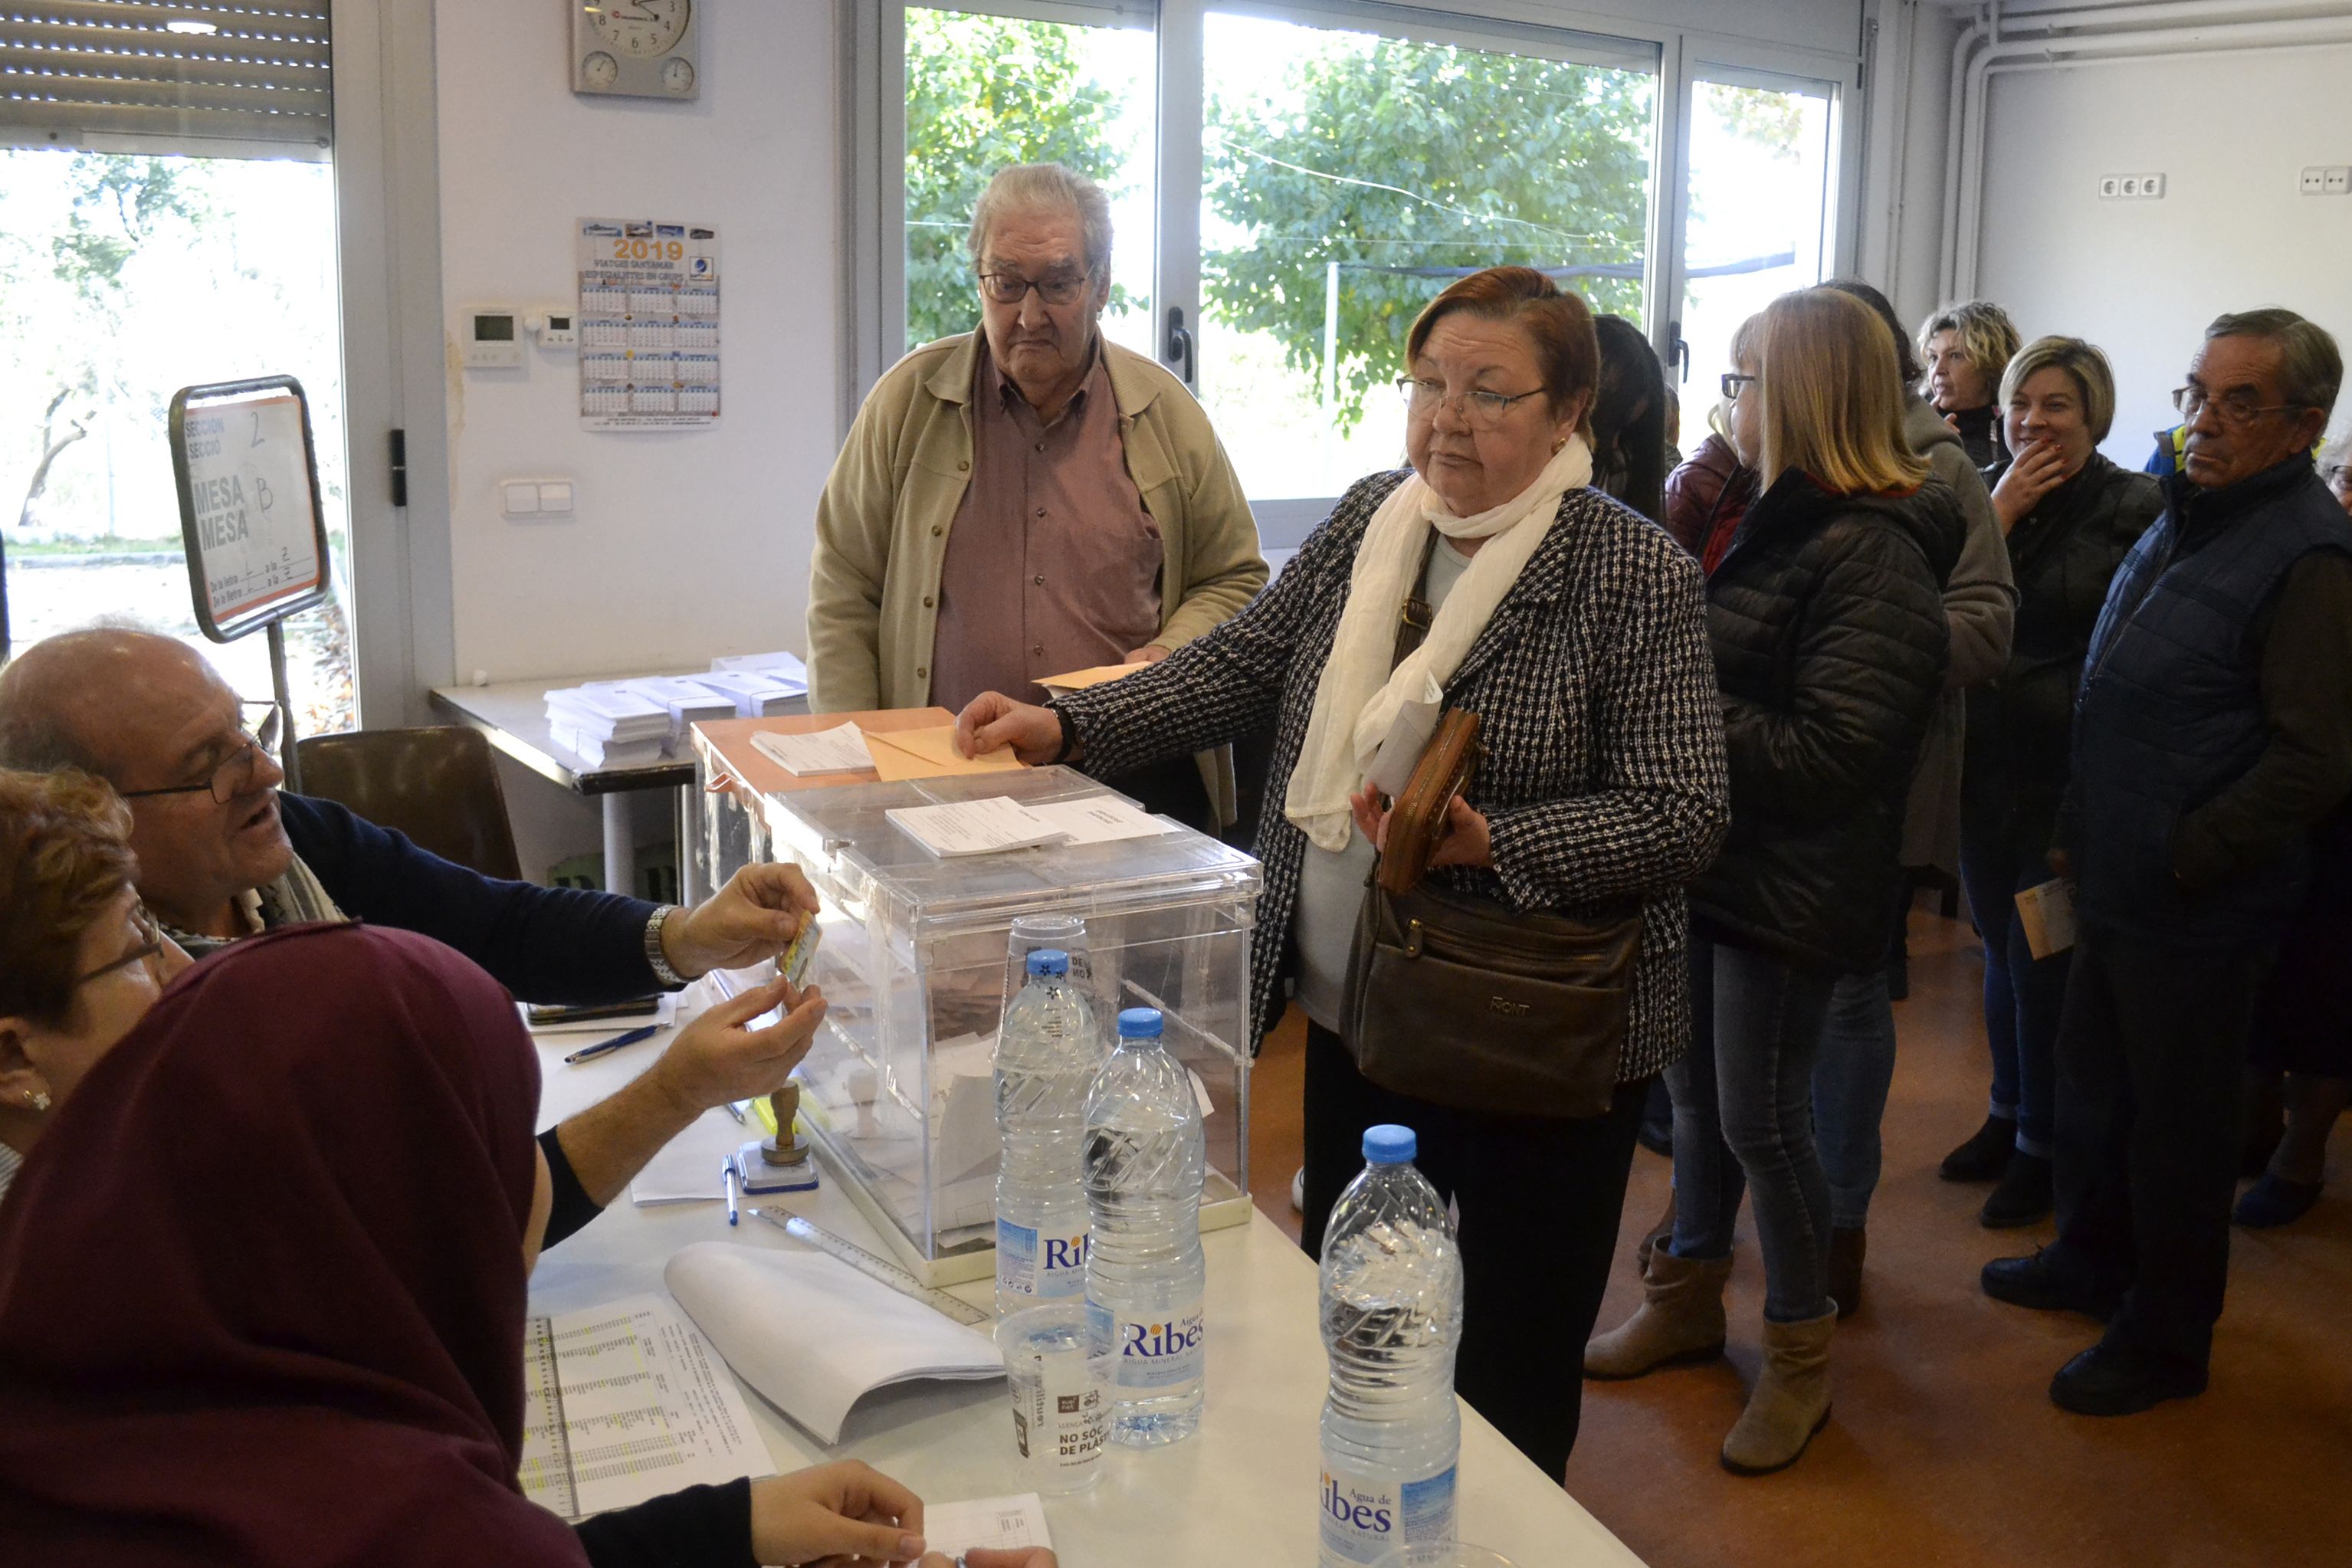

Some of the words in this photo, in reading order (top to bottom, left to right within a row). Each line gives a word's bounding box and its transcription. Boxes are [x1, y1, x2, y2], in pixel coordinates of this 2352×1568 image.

[669, 2, 675, 12] 3
[599, 15, 606, 26] 8
[663, 21, 671, 31] 4
[613, 30, 619, 41] 7
[651, 34, 657, 44] 5
[631, 38, 638, 48] 6
[614, 238, 683, 261] 2019
[251, 411, 265, 448] 2
[194, 474, 244, 515] MESA
[256, 477, 274, 513] B
[201, 509, 249, 551] MESA
[1123, 1318, 1204, 1358] Ribes
[1060, 1433, 1078, 1444] NO
[1060, 1446, 1076, 1455] DE
[1320, 1468, 1392, 1533] ibes
[1349, 1488, 1375, 1504] Agua
[1378, 1494, 1392, 1505] de
